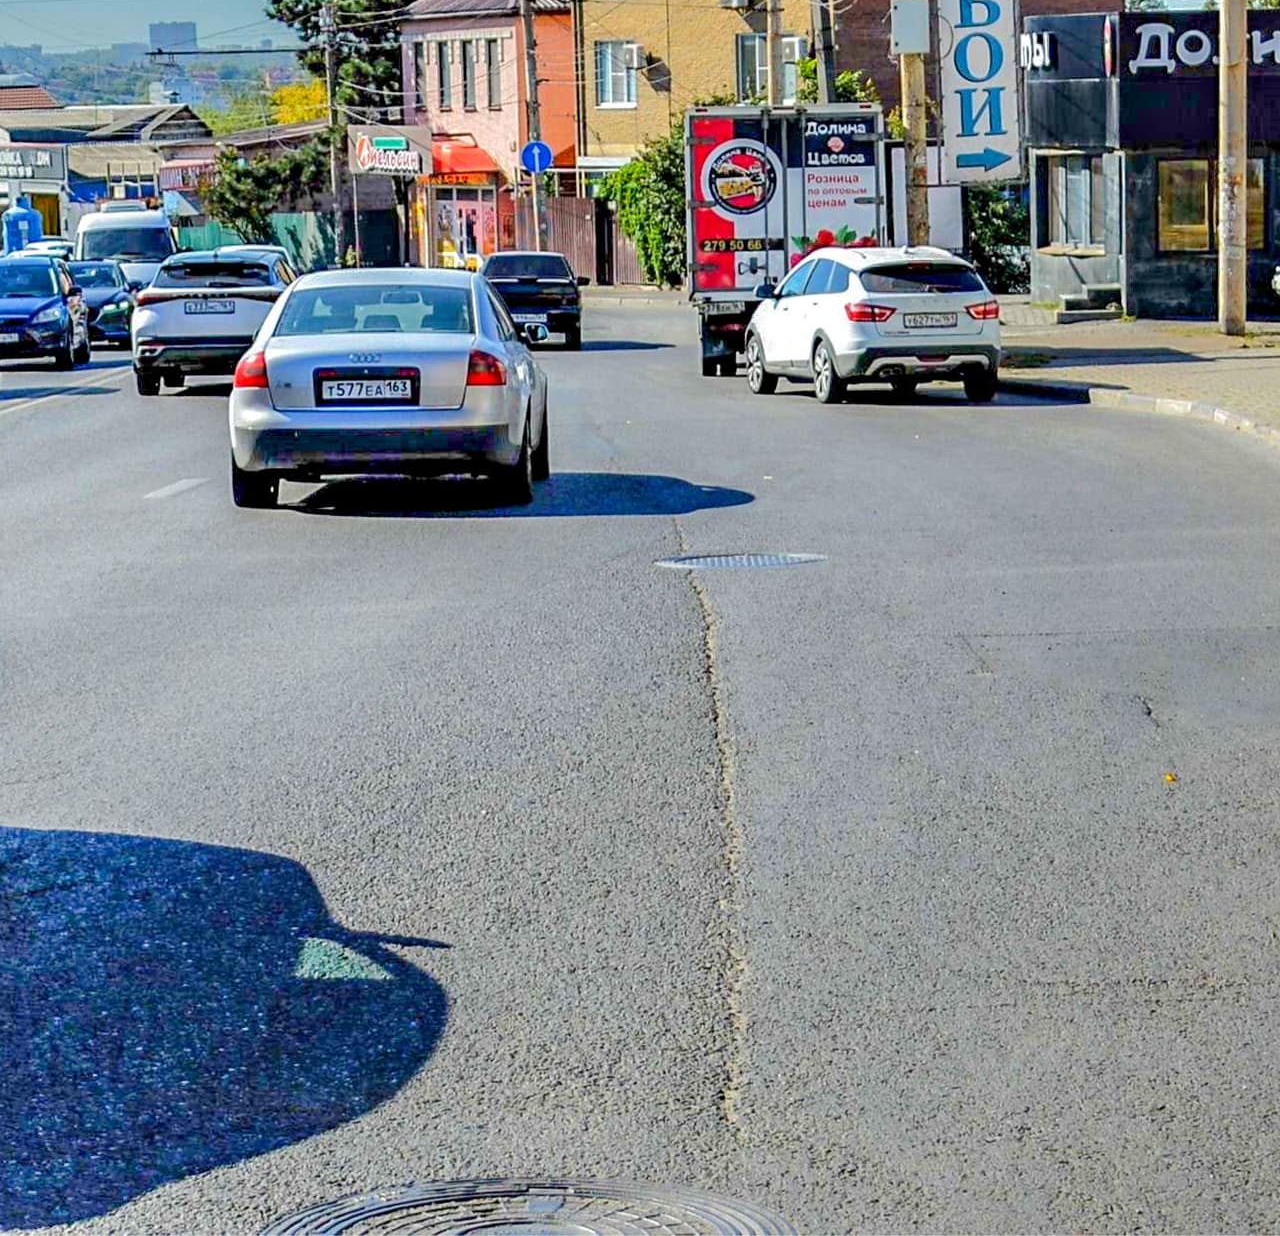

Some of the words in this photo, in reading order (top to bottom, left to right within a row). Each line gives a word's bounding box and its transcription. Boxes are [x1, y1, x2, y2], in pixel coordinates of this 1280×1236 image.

[807, 173, 859, 185] Розница
[807, 199, 847, 209] ценам
[703, 240, 726, 251] 279
[729, 240, 745, 251] 50
[327, 382, 384, 397] Т577ЕА
[386, 380, 408, 393] 163
